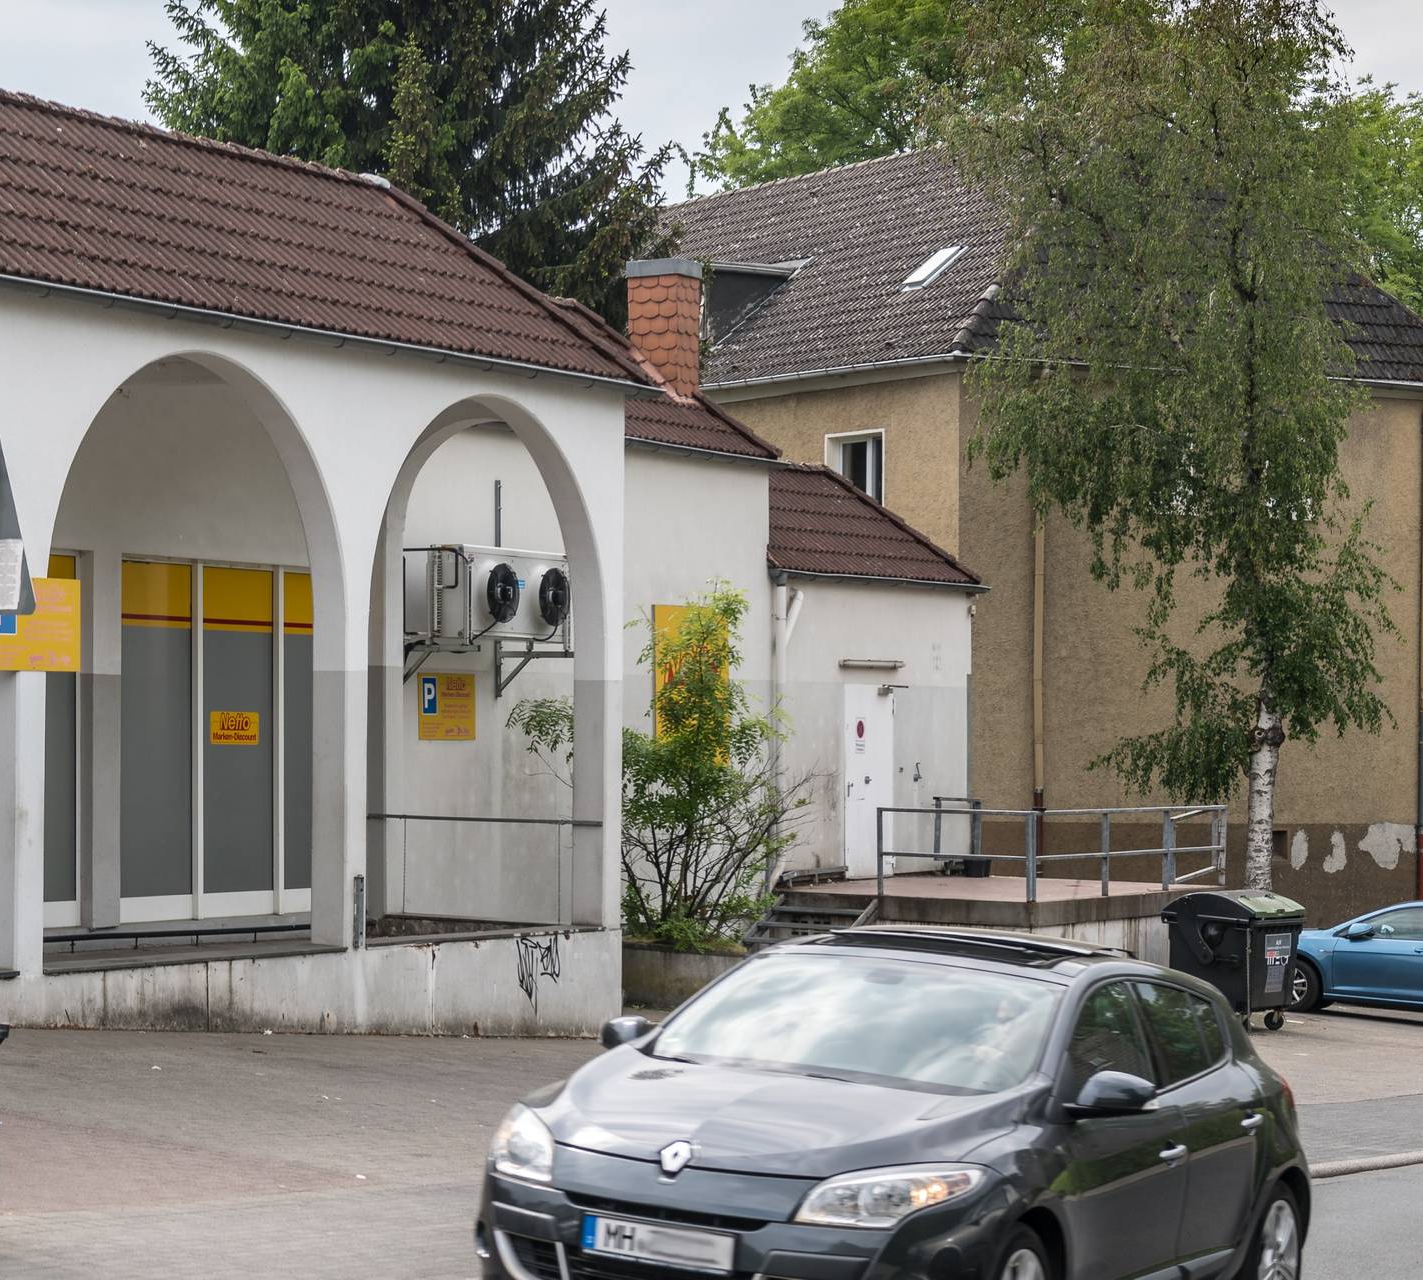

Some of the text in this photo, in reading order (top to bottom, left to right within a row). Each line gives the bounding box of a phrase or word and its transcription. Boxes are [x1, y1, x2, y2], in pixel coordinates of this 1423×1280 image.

[423, 683, 435, 708] P
[220, 711, 250, 731] Netto
[212, 731, 257, 742] Marken-Discount
